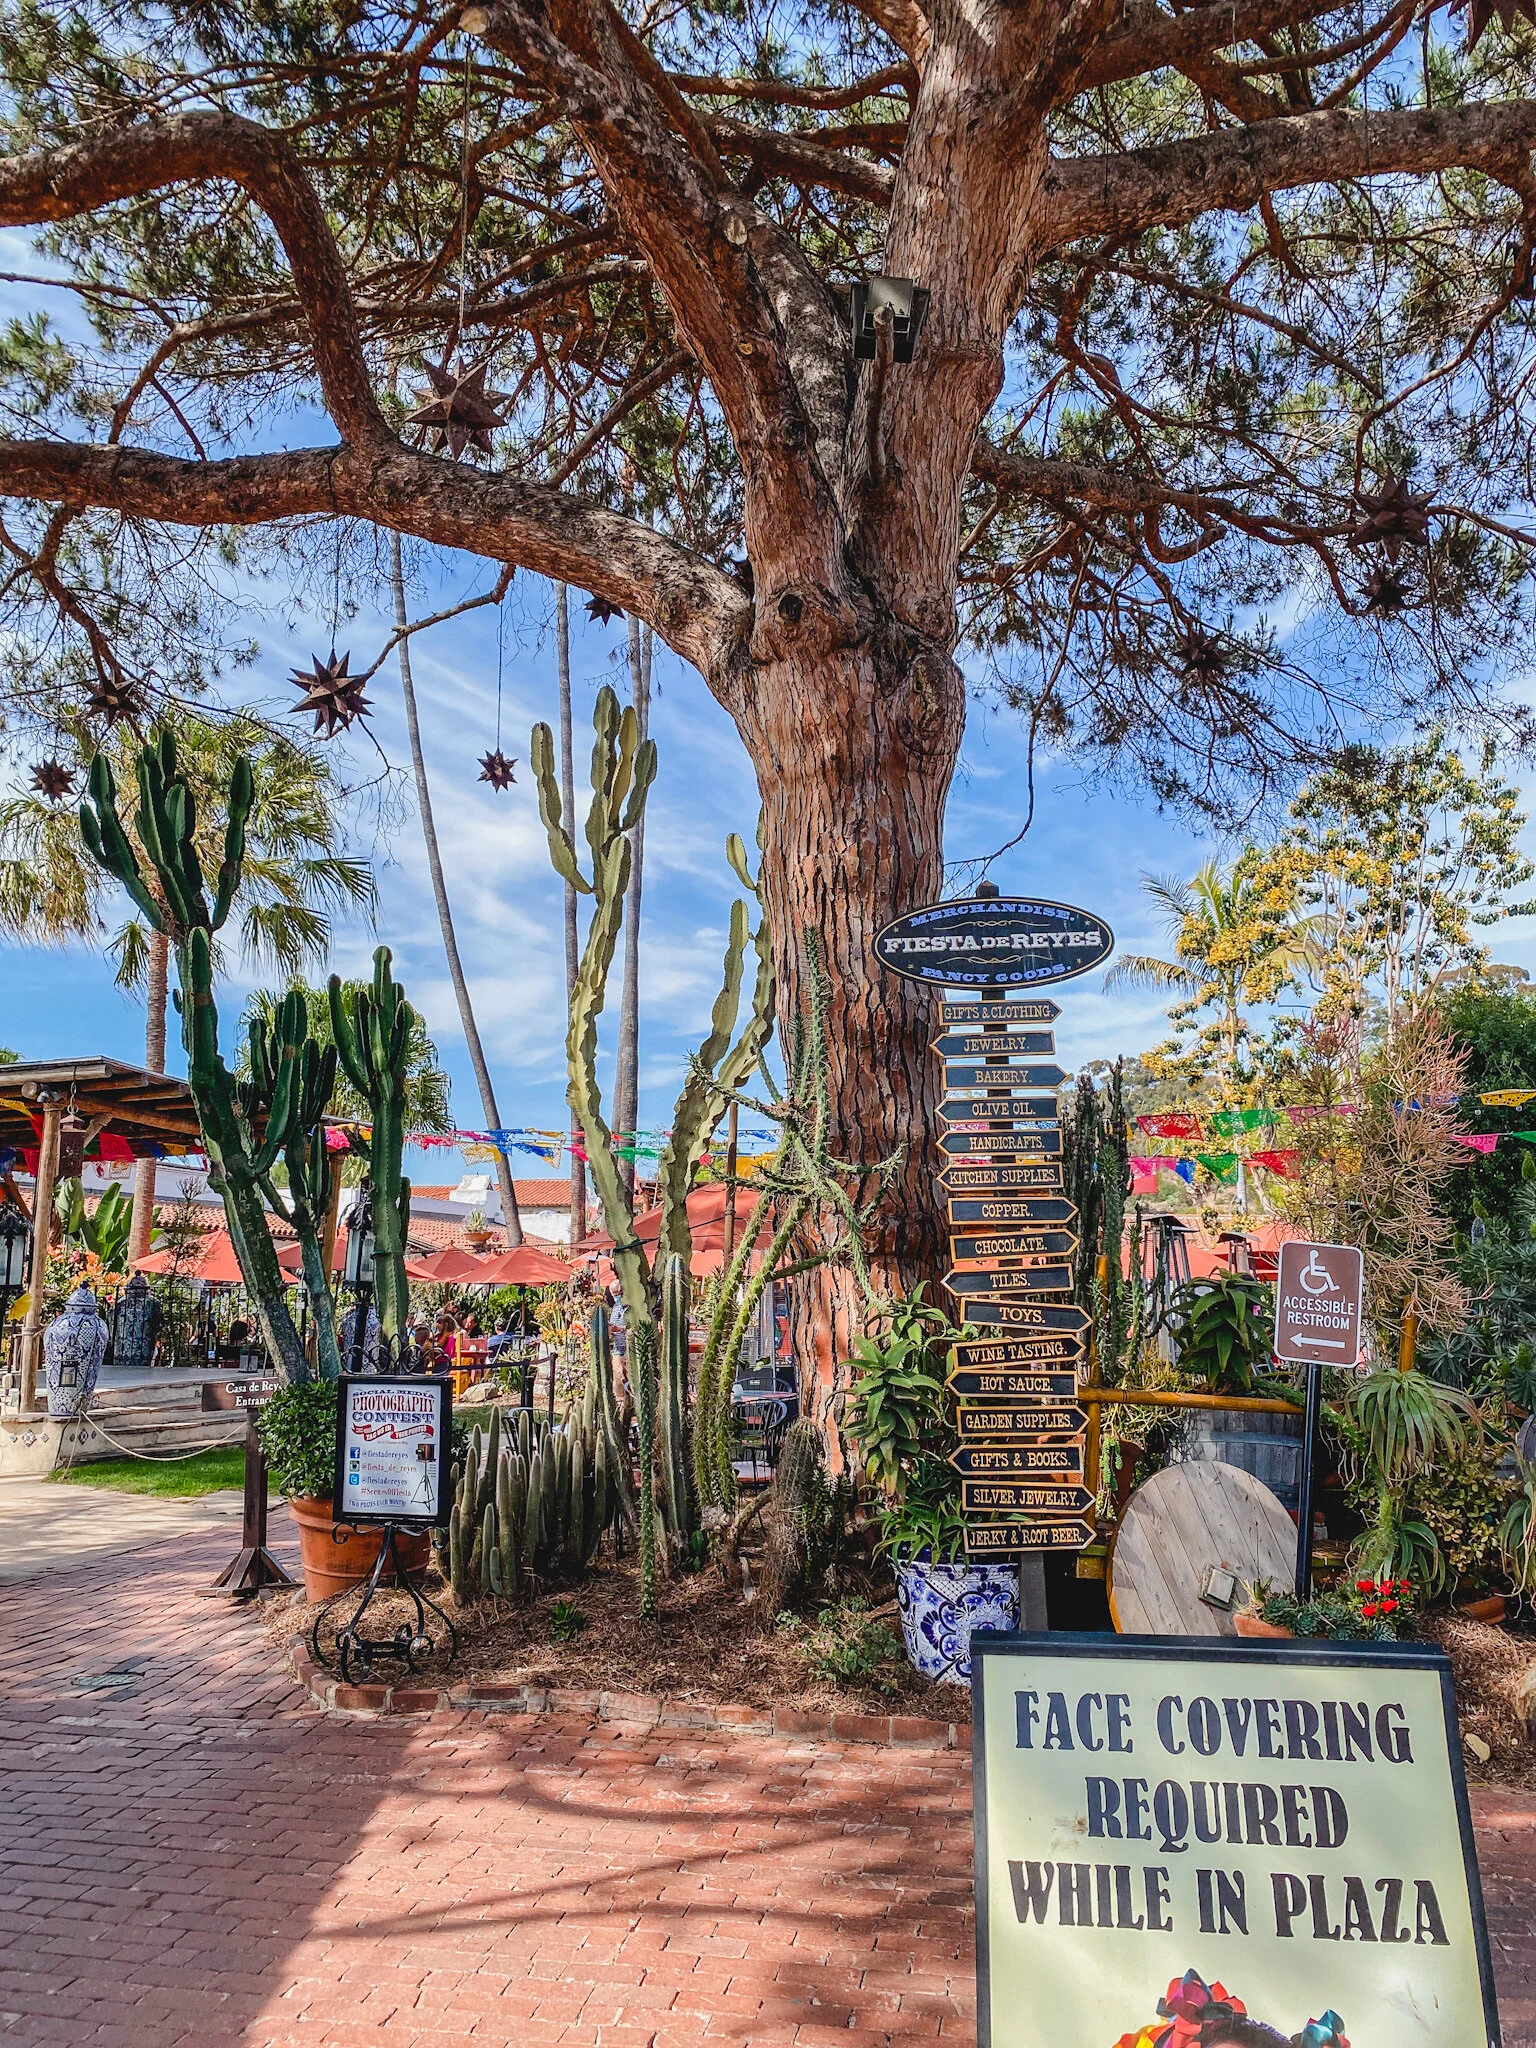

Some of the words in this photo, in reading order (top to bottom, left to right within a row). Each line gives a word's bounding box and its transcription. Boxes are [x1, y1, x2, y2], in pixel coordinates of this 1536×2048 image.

[909, 903, 1075, 927] MERCHANDISE.
[884, 934, 981, 954] FIESTA
[982, 937, 1010, 949] DE
[1011, 931, 1101, 949] REYES
[920, 966, 990, 983] FANCY
[996, 963, 1072, 983] GOODS.
[944, 1006, 978, 1020] GIFTS
[982, 1007, 990, 1019] &
[991, 1004, 1055, 1019] CLOTHING.
[963, 1036, 1030, 1052] JEWELRY.
[975, 1070, 1032, 1083] BAKERY.
[972, 1102, 1010, 1115] OLIVE
[1013, 1102, 1036, 1115] OIL.
[969, 1136, 1045, 1150] HANDICRAFTS.
[949, 1170, 998, 1185] KITCHEN
[1001, 1168, 1058, 1183] SUPPLIES.
[981, 1204, 1034, 1217] COPPER.
[974, 1237, 1048, 1254] CHOCOLATE.
[990, 1273, 1031, 1287] TILES.
[1283, 1295, 1355, 1316] ACCESSIBLE
[1000, 1307, 1046, 1323] TOYS.
[1287, 1311, 1350, 1330] RESTROOM
[966, 1346, 1004, 1363] WINE
[1008, 1341, 1068, 1360] TASTING.
[225, 1382, 247, 1394] Casa
[249, 1381, 260, 1392] de
[979, 1376, 1004, 1391] HOT
[1009, 1377, 1054, 1392] SAUCE.
[352, 1389, 394, 1397] SOCIAL
[397, 1389, 435, 1399] MEDIA
[352, 1395, 435, 1412] PHOTOGRAPHY
[352, 1411, 435, 1424] CONTEST
[966, 1414, 1013, 1429] GARDEN
[1016, 1413, 1074, 1428] SUPPLIES.
[970, 1452, 1009, 1467] GIFTS
[1013, 1453, 1022, 1467] &
[1027, 1451, 1071, 1467] BOOKS.
[973, 1488, 1016, 1504] SILVER
[1019, 1490, 1080, 1506] JEWELRY.
[970, 1530, 1007, 1546] JERKY
[1011, 1531, 1018, 1545] &
[1022, 1528, 1048, 1544] ROOT
[1051, 1527, 1084, 1543] BEER.
[1013, 1690, 1133, 1754] FACE
[1156, 1694, 1414, 1764] COVERING
[1084, 1775, 1350, 1853] REQUIRED
[1007, 1860, 1173, 1932] WHILE
[1195, 1868, 1250, 1936] IN
[1269, 1872, 1451, 1946] PLAZA
